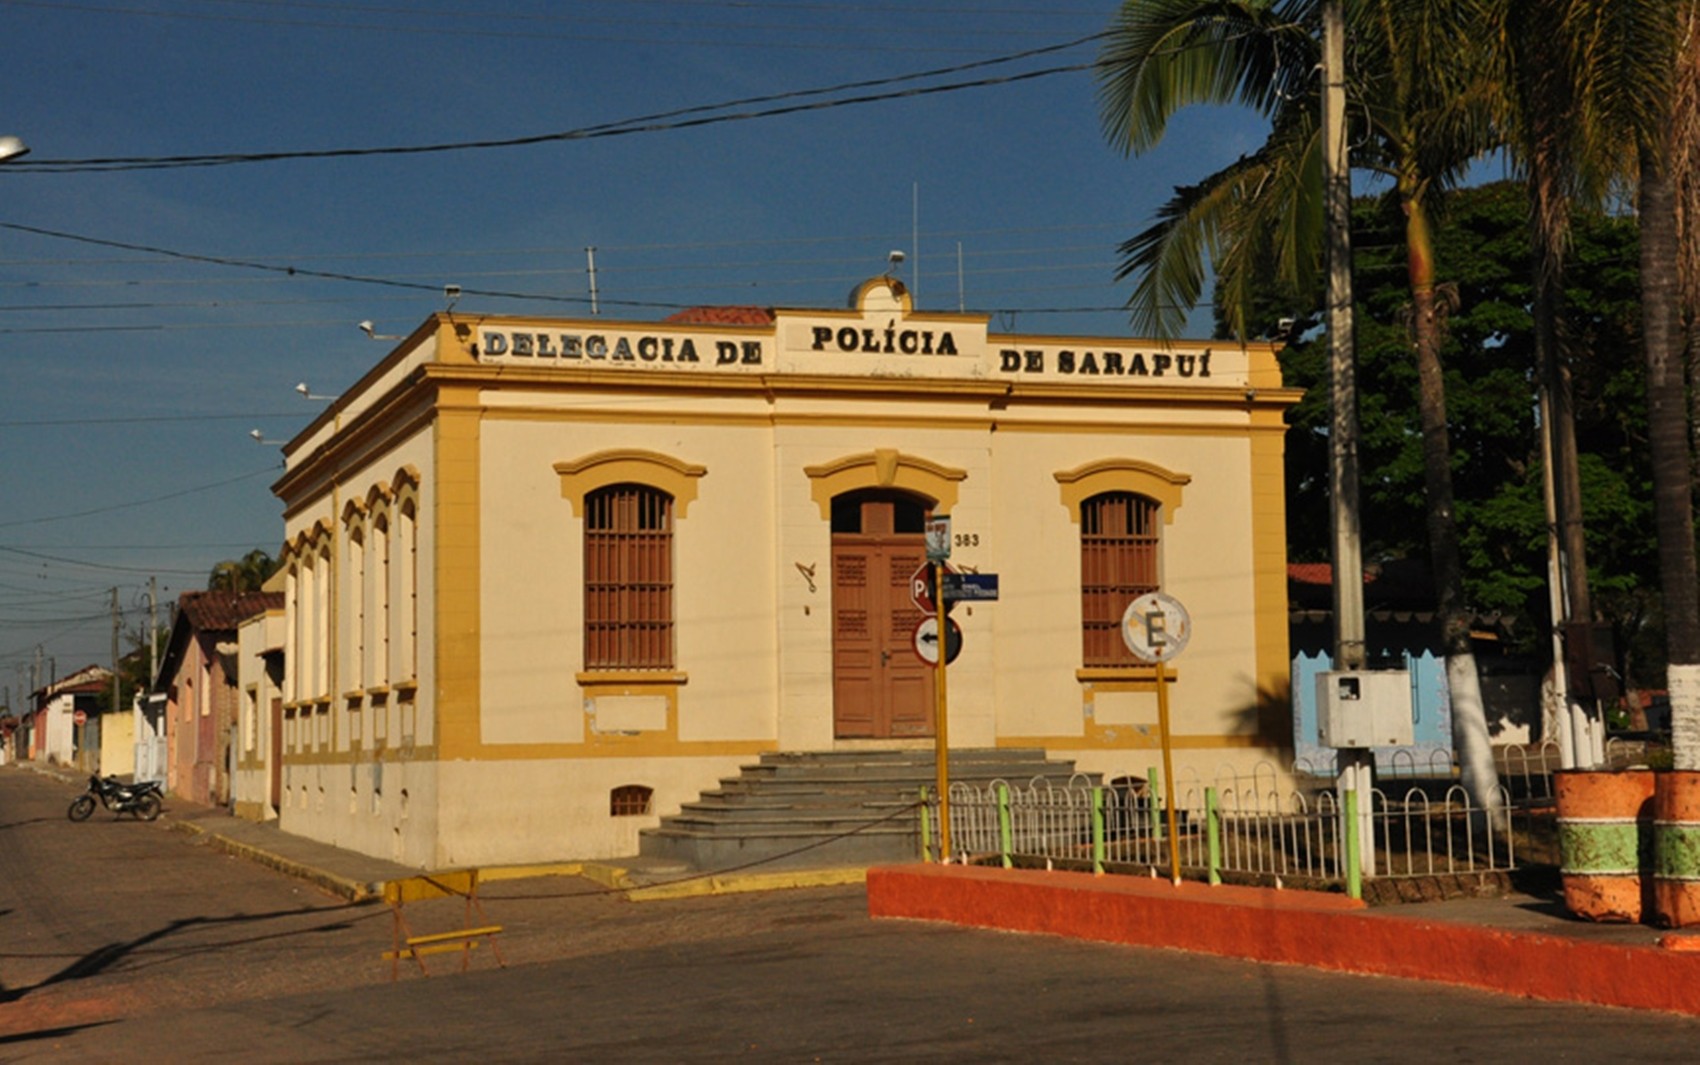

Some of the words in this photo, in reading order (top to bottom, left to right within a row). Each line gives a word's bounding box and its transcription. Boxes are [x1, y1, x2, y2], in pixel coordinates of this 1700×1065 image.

[483, 331, 700, 362] DELEGACIA
[716, 341, 762, 365] DE
[811, 319, 958, 356] POLÍCIA
[1000, 350, 1045, 373] DE
[1057, 348, 1211, 377] SARAPUÍ
[954, 534, 979, 547] 383
[1145, 611, 1167, 647] E
